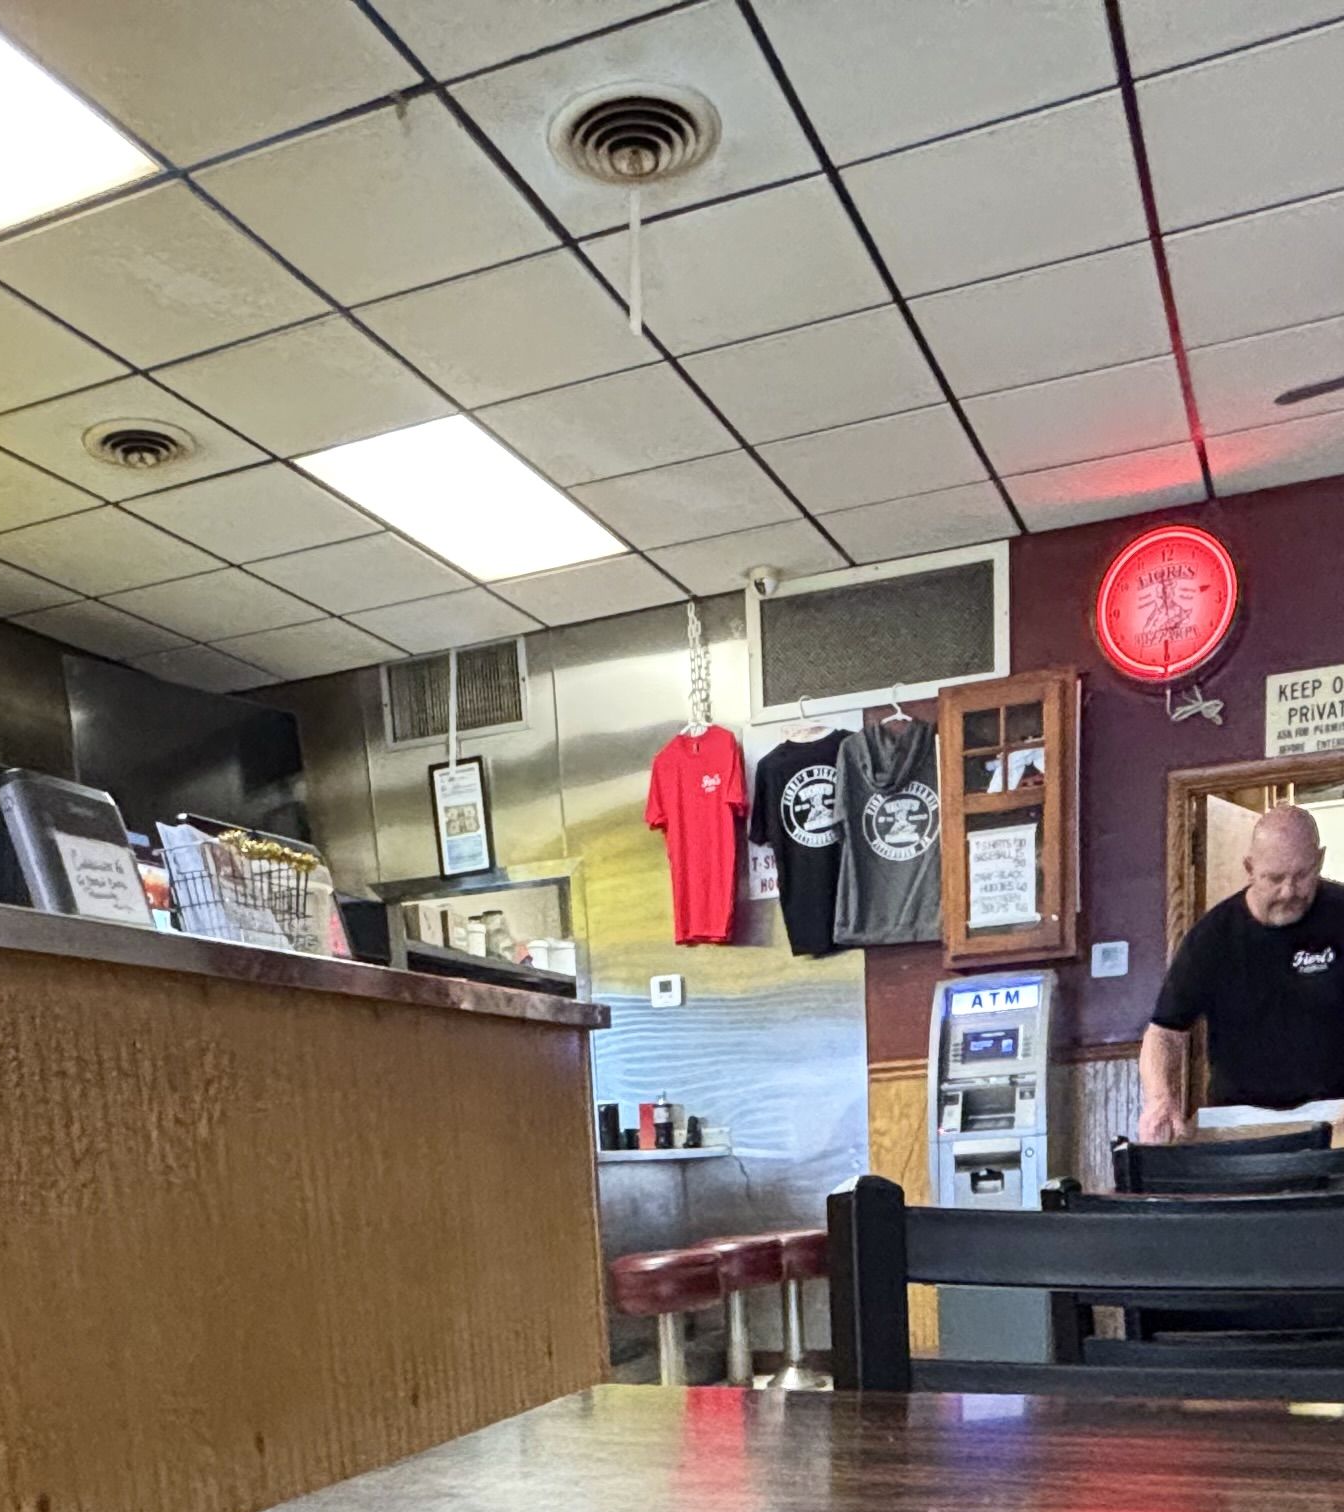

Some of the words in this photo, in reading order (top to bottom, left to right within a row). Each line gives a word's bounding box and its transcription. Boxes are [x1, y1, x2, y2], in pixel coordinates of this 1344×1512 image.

[1162, 549, 1174, 562] 12
[1279, 679, 1322, 702] KEEP
[971, 990, 1021, 1008] ATM
